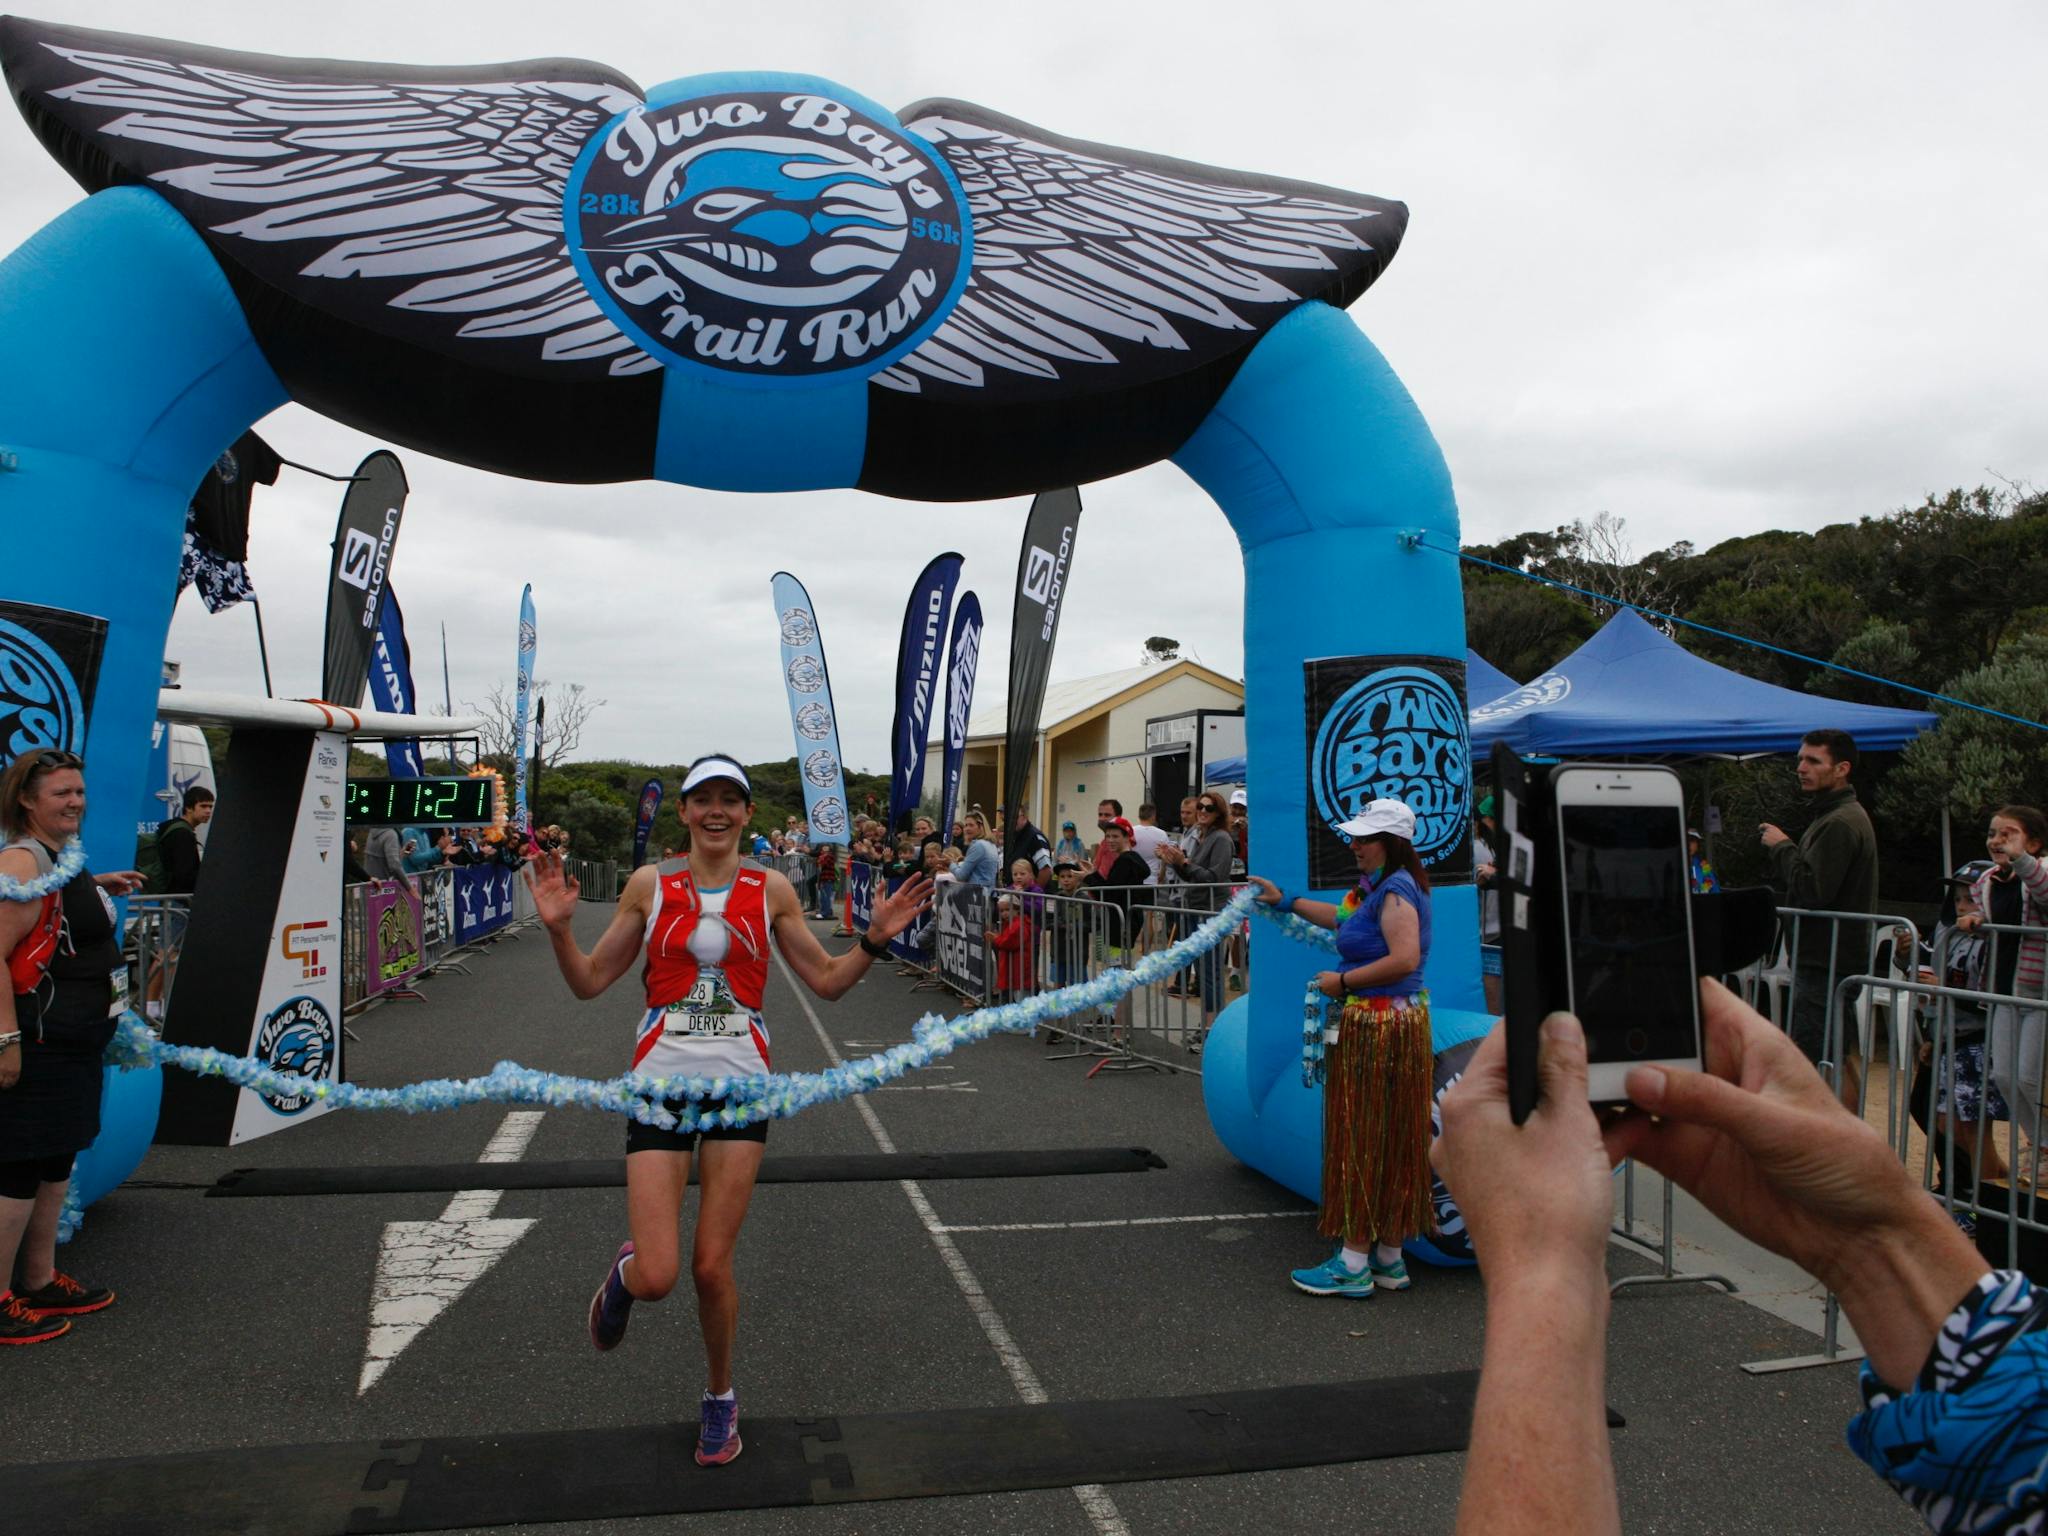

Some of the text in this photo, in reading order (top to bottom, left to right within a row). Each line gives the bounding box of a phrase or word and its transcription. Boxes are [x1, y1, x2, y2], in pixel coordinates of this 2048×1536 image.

[605, 95, 943, 209] Two Bays
[581, 193, 640, 216] 28k
[912, 217, 961, 246] 56k
[605, 253, 937, 365] Trail Run
[1344, 687, 1457, 740] TWO
[690, 984, 706, 1000] 28
[261, 999, 331, 1053] Two Bays
[688, 1015, 726, 1031] DERVS
[274, 1094, 302, 1111] rail
